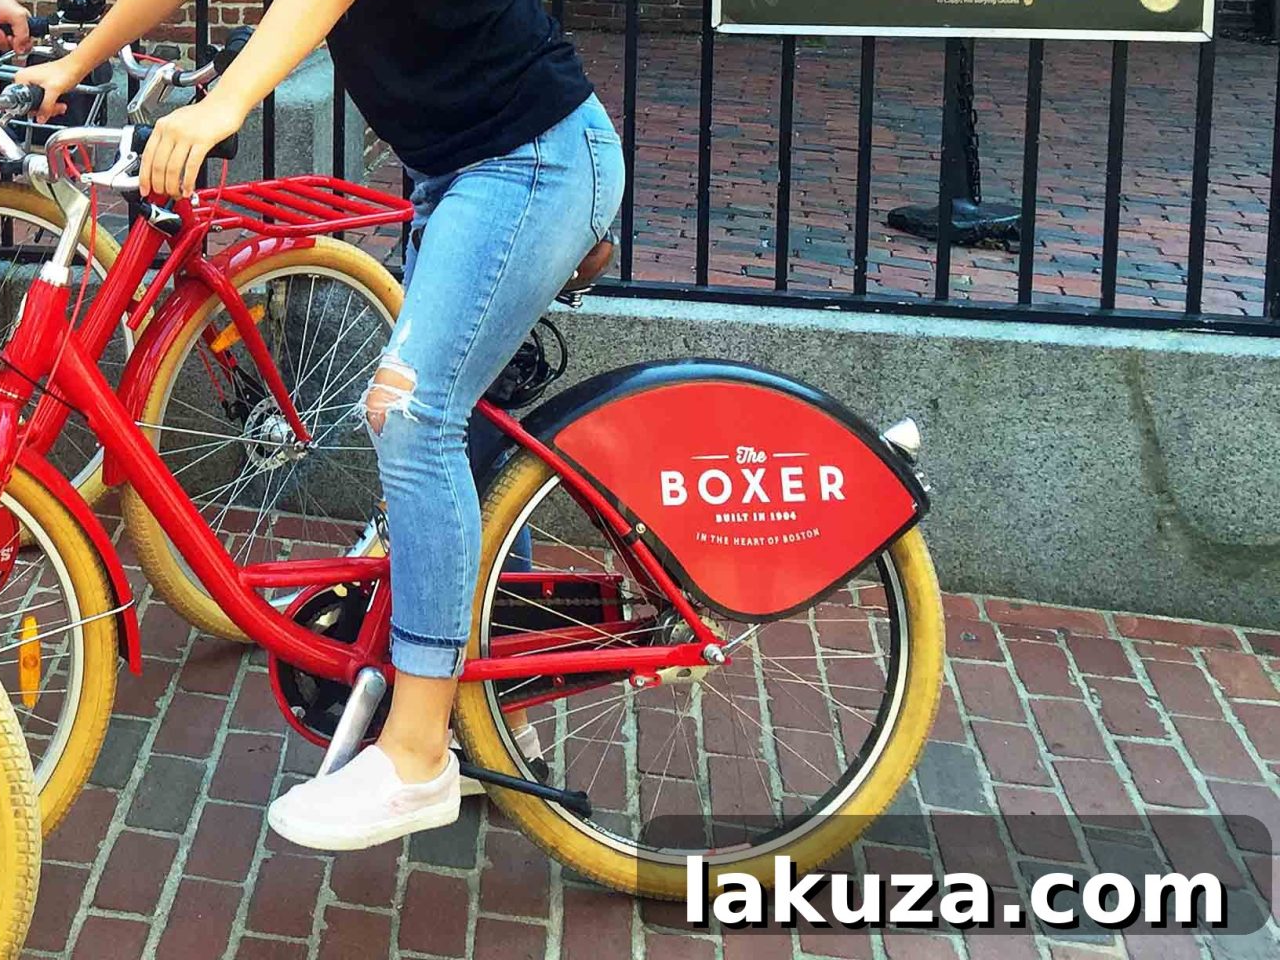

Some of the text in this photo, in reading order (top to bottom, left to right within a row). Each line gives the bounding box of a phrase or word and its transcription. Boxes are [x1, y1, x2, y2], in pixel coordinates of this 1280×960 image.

[736, 446, 767, 464] The
[660, 465, 846, 506] BOXER
[715, 513, 748, 523] BUILT
[753, 512, 766, 522] IN
[696, 527, 821, 546] IN THE HEART OF BOSTON
